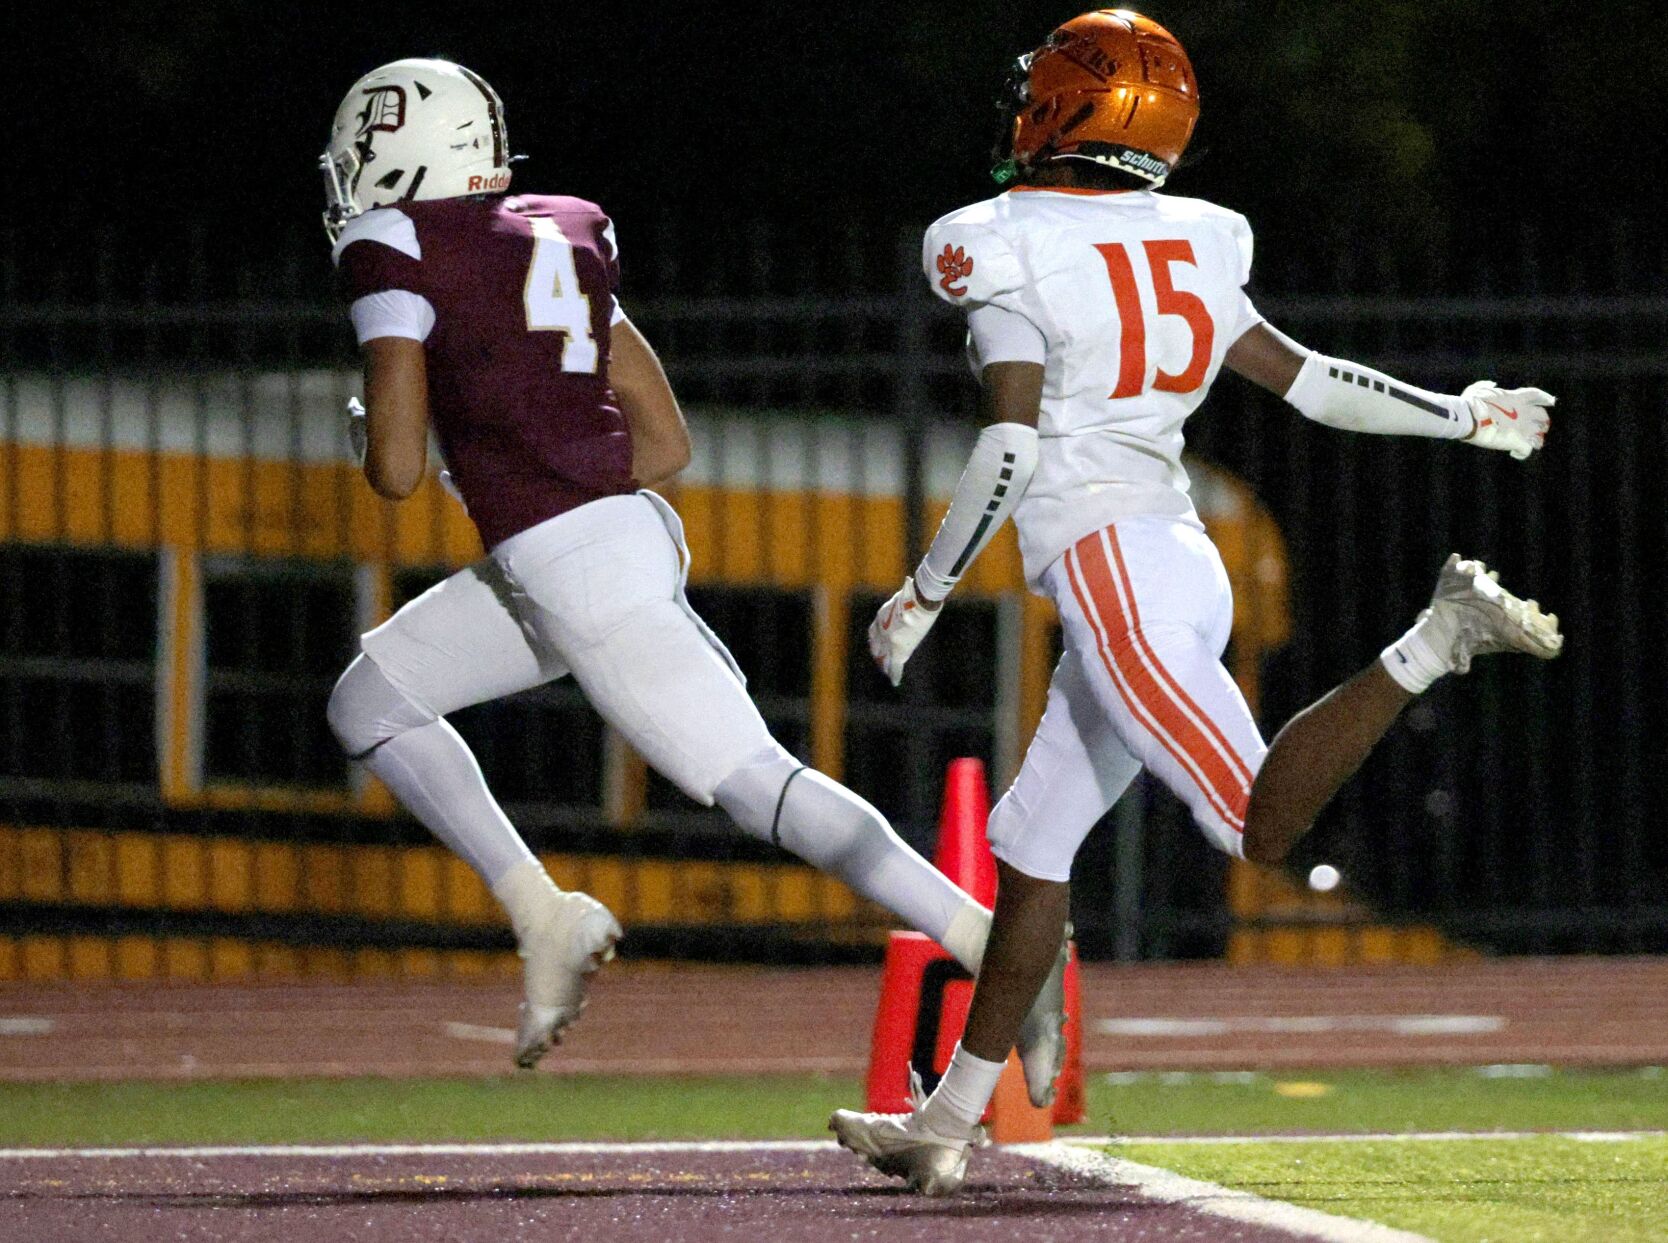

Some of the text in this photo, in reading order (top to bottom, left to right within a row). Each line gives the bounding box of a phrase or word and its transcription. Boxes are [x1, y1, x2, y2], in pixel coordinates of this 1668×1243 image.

[355, 85, 406, 133] D
[468, 174, 509, 191] Ridd
[523, 217, 598, 374] 4
[1092, 239, 1214, 399] 15
